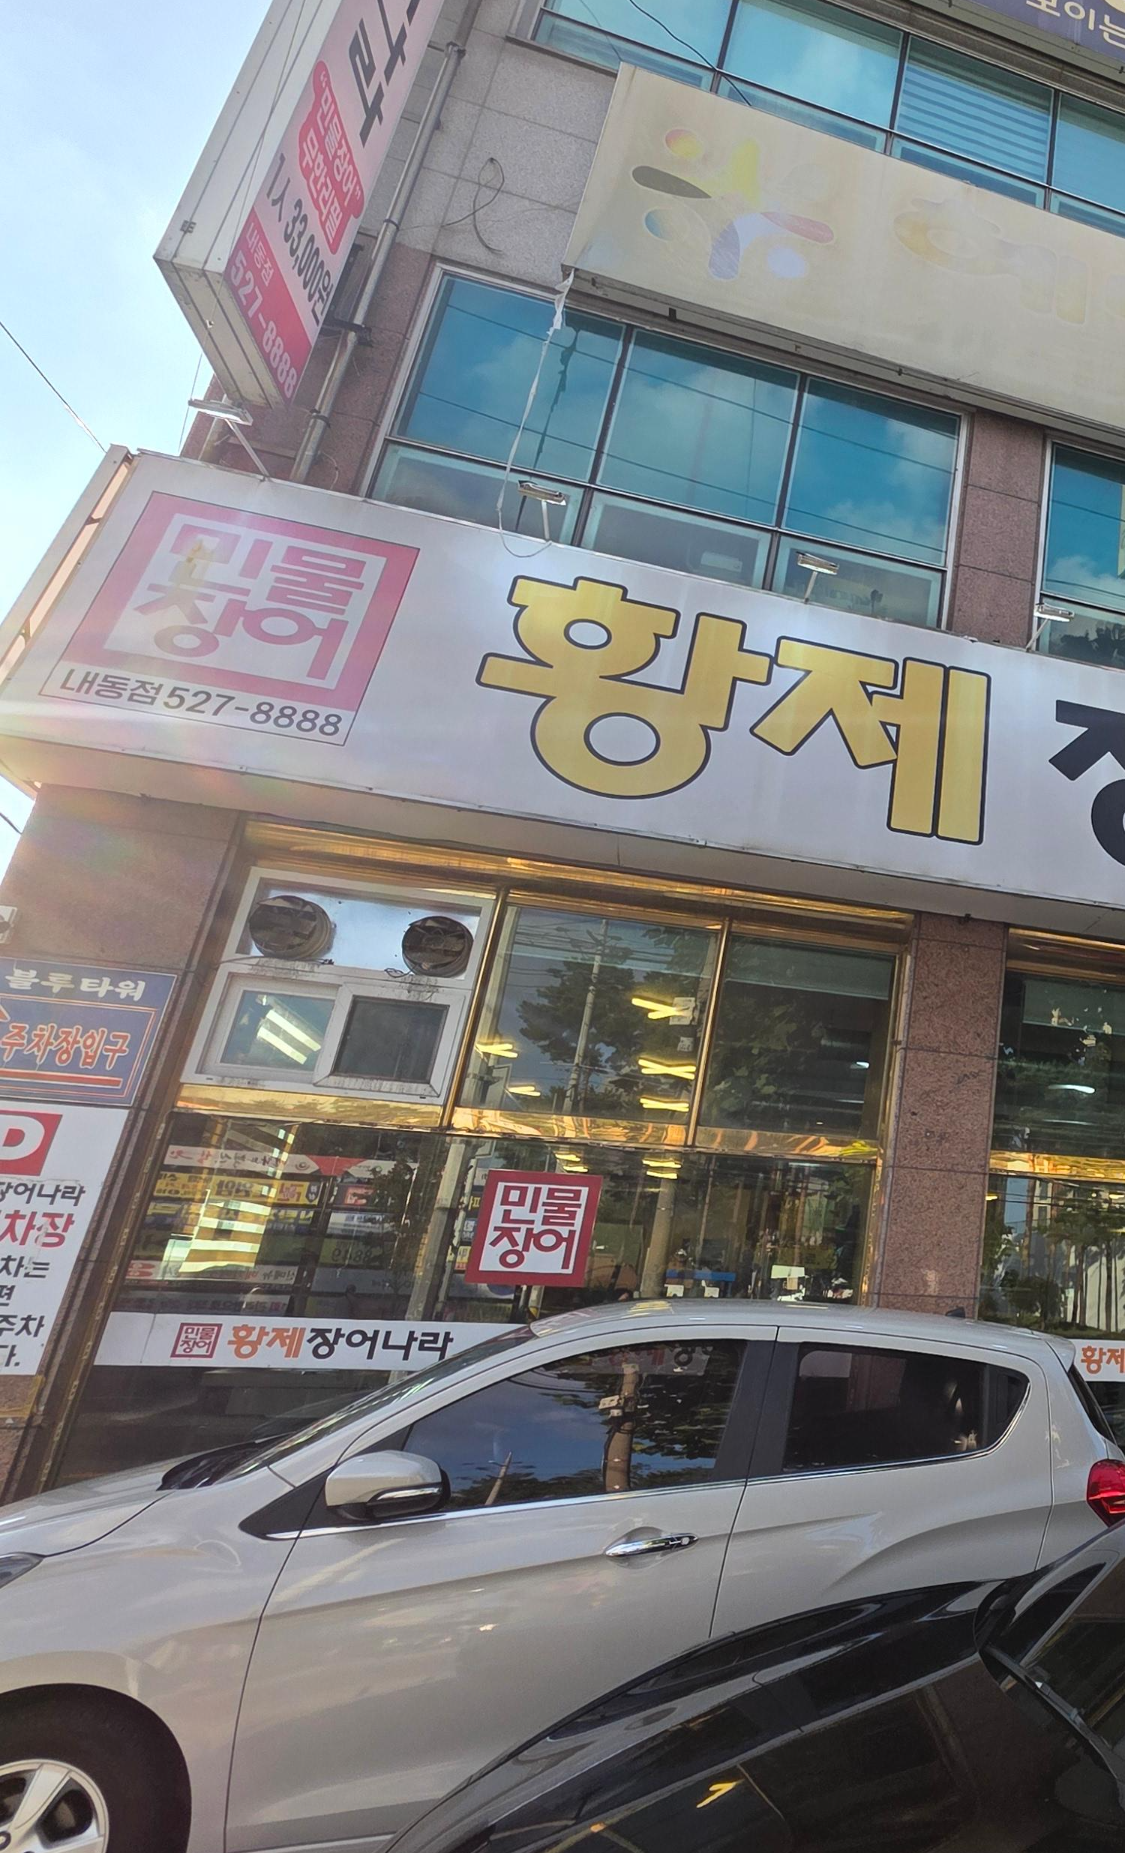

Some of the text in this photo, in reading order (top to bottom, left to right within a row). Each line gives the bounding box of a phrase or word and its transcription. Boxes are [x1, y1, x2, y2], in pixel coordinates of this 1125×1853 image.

[302, 128, 343, 244] 무한리필
[245, 222, 274, 286] 내동점
[284, 198, 334, 327] 33,000원
[230, 250, 297, 399] 527-8888
[168, 523, 367, 615] 민물
[133, 583, 349, 681] 장어
[475, 574, 992, 845] 황제
[0, 1023, 131, 1071] 주차장입구
[501, 1185, 582, 1227] 민물
[489, 1226, 577, 1269] 장어
[180, 1339, 212, 1355] 장어
[185, 1326, 215, 1340] 민물
